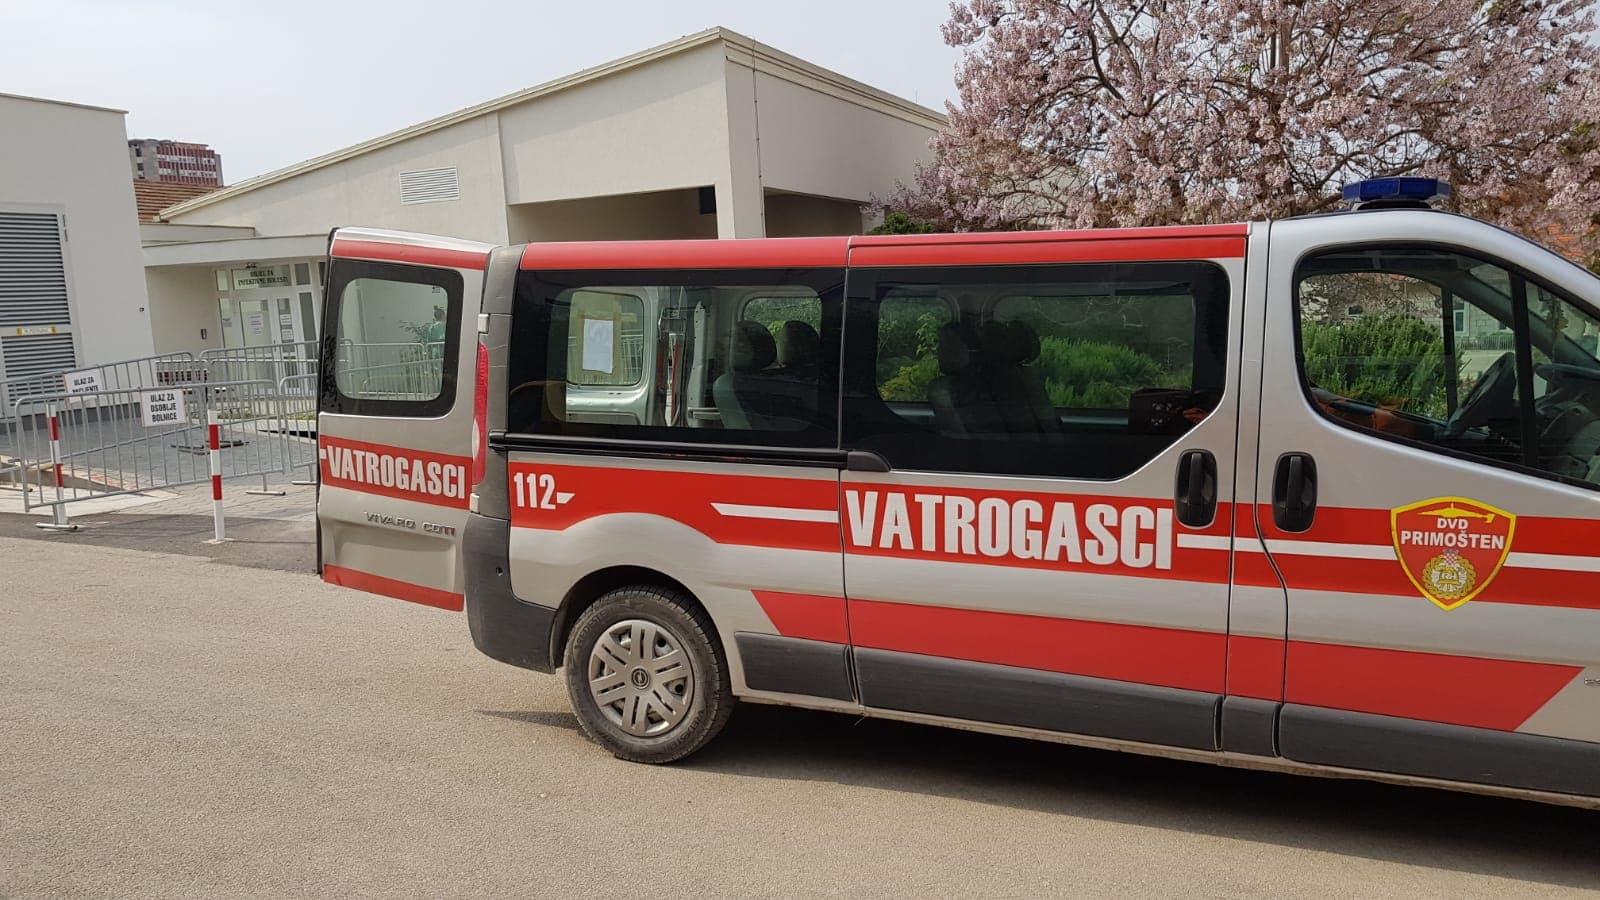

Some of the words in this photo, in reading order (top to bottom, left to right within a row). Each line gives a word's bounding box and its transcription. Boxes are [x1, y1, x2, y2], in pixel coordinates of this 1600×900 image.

[74, 377, 87, 386] ULAZ
[88, 376, 94, 384] ZA
[150, 393, 166, 403] ULAZ
[167, 393, 175, 401] ZA
[150, 403, 177, 413] OSOBLJE
[152, 412, 177, 423] BOLNICE
[327, 445, 465, 499] VATROGASCI
[514, 472, 557, 510] 112
[364, 511, 416, 529] VIVARO
[1437, 518, 1469, 530] DVD
[846, 490, 1173, 570] VATROGASCI
[1400, 529, 1504, 550] PRIMOŠTEN
